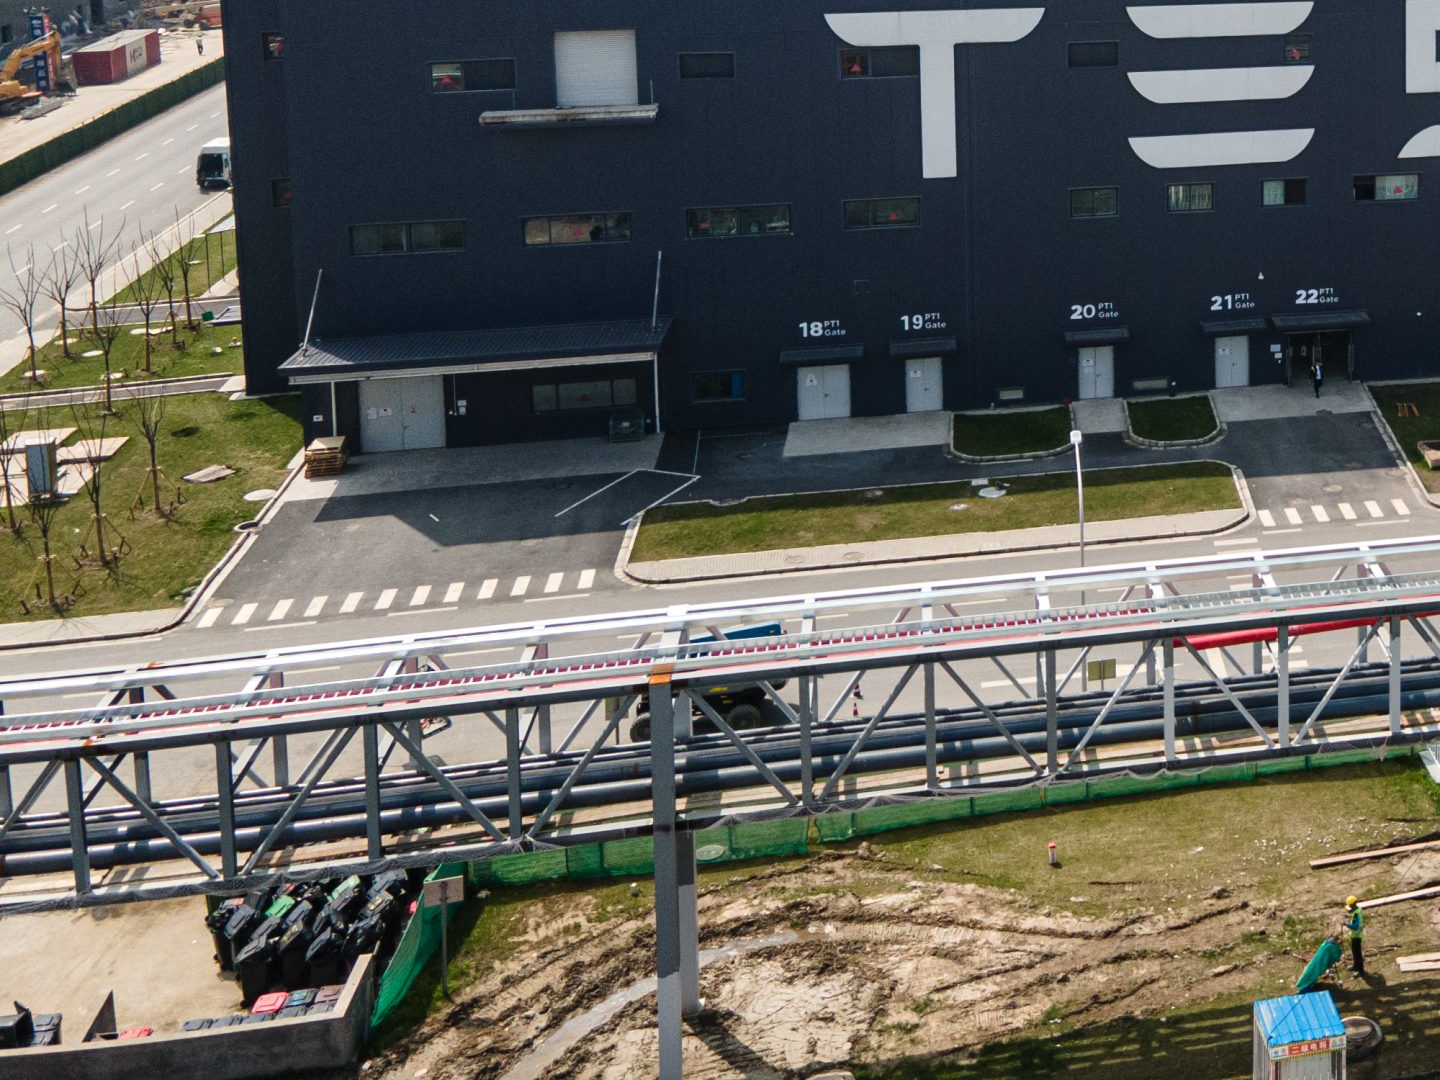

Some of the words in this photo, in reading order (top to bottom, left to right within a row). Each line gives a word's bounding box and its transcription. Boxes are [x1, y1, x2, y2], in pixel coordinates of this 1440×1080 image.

[1319, 287, 1334, 295] PT1
[1235, 292, 1250, 300] PT1
[1295, 288, 1318, 305] 22
[1319, 295, 1339, 304] Gate
[1098, 302, 1113, 310] PT1
[1210, 294, 1233, 311] 21
[1235, 300, 1256, 309] Gate
[1070, 303, 1096, 320] 20
[1098, 310, 1119, 319] Gate
[924, 312, 940, 321] PT1
[824, 319, 840, 328] PT1
[900, 314, 923, 331] 19
[925, 321, 947, 329] Gate
[799, 321, 823, 338] 18
[824, 328, 847, 337] Gate
